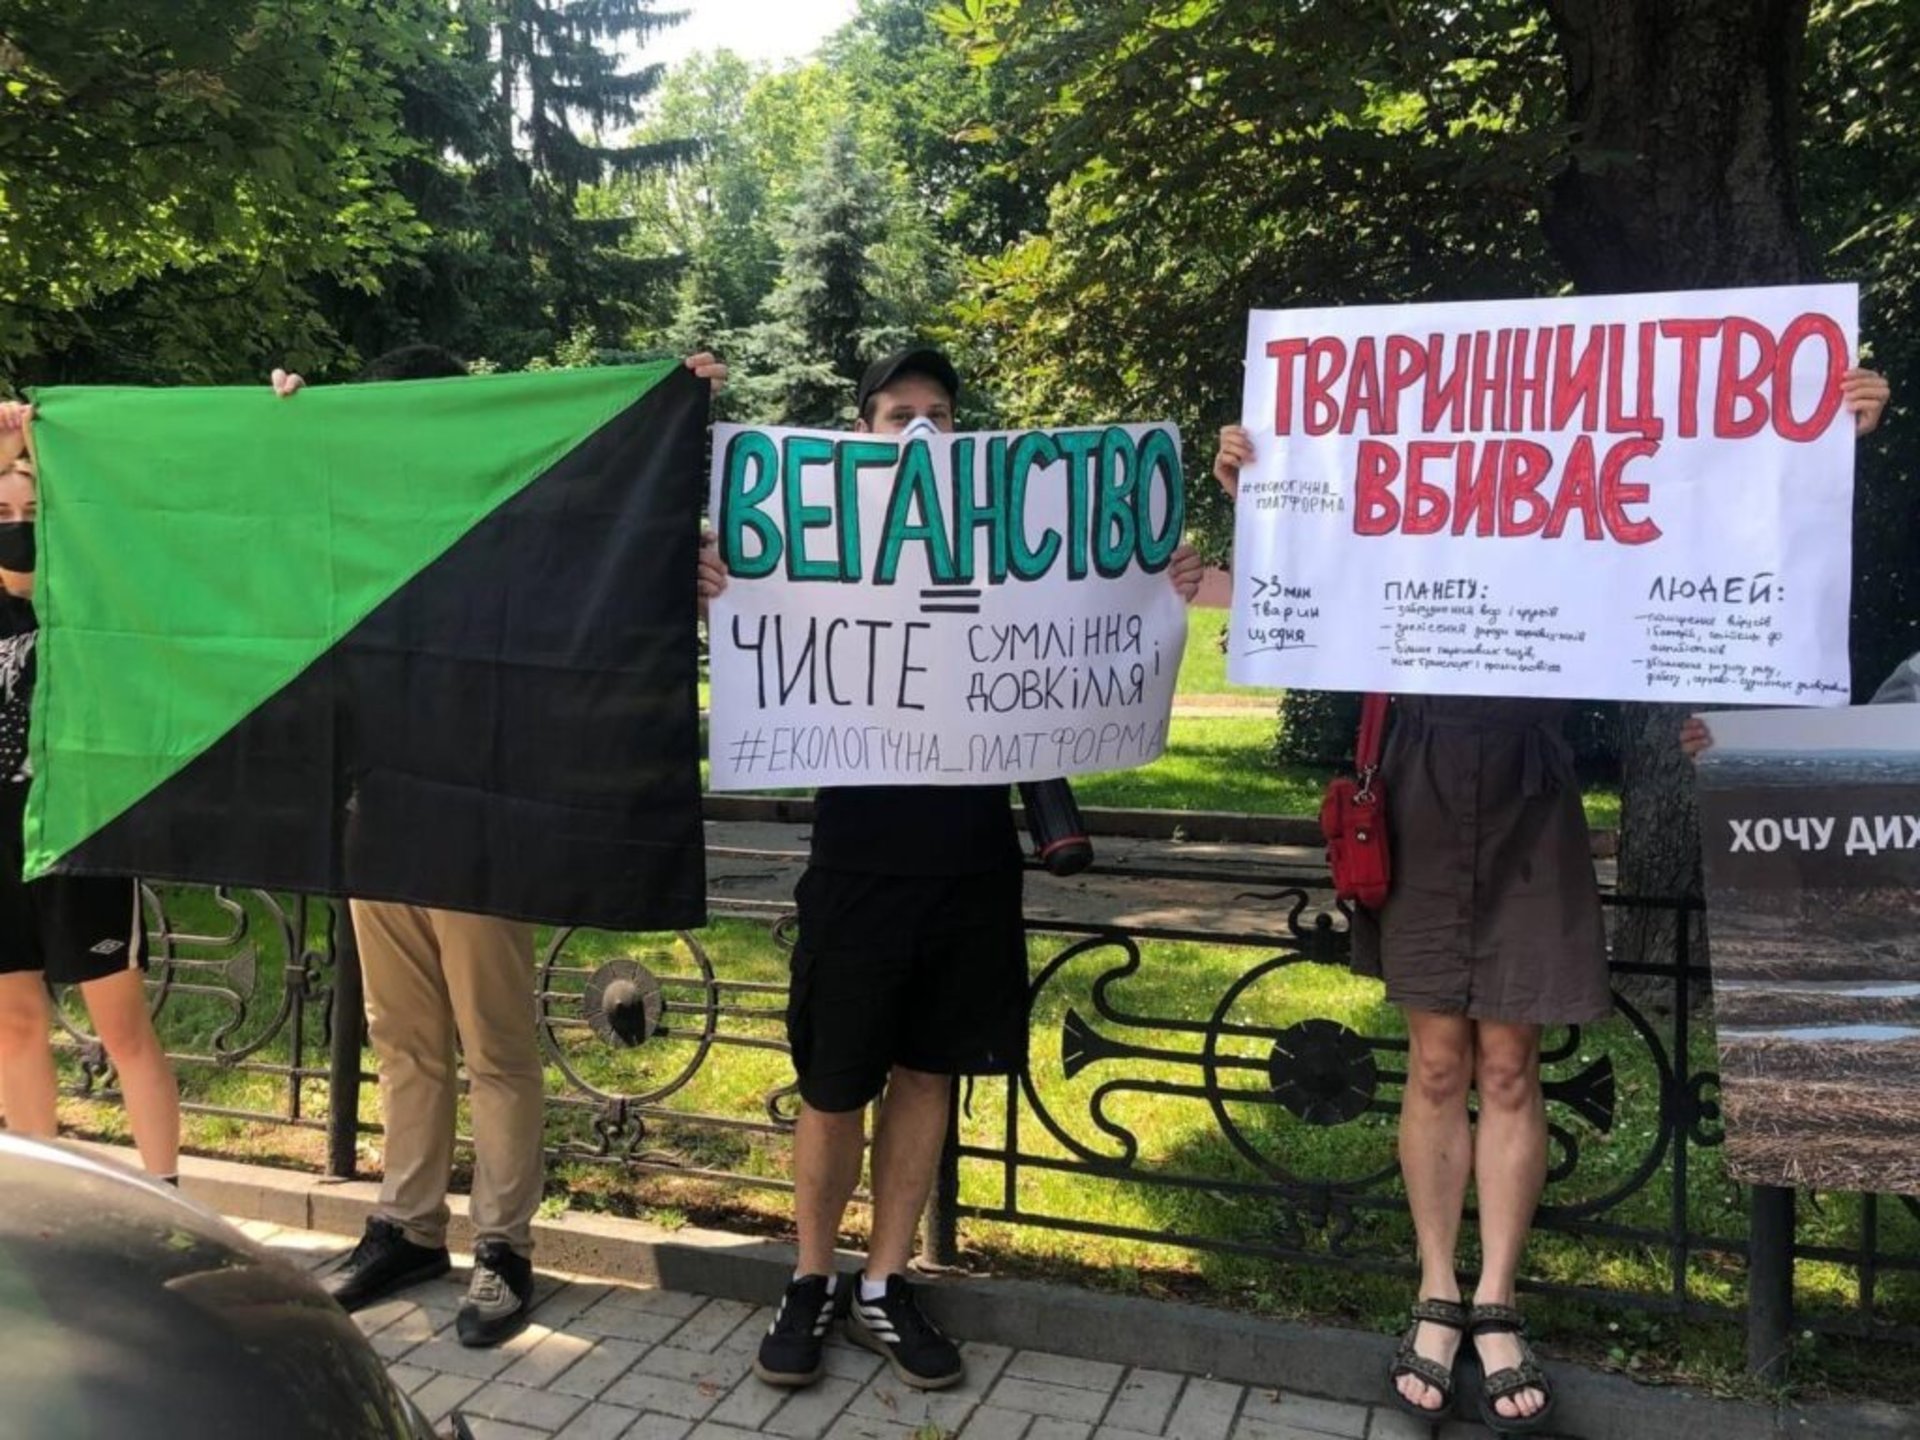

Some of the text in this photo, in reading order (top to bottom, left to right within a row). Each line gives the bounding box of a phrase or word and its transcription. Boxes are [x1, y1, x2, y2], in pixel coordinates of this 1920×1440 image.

[1266, 313, 1850, 442] ТВАРИННИЦТВО
[719, 426, 1186, 584] ВЕГАНСТВО
[1353, 434, 1662, 545] ВБИВАЄ
[1385, 579, 1489, 600] ПЛАНЕТУ:
[1649, 572, 1784, 604] ЛЮДЕЙ:
[731, 613, 931, 711] ЧИСТЕ
[1728, 816, 1836, 853] ХОЧУ
